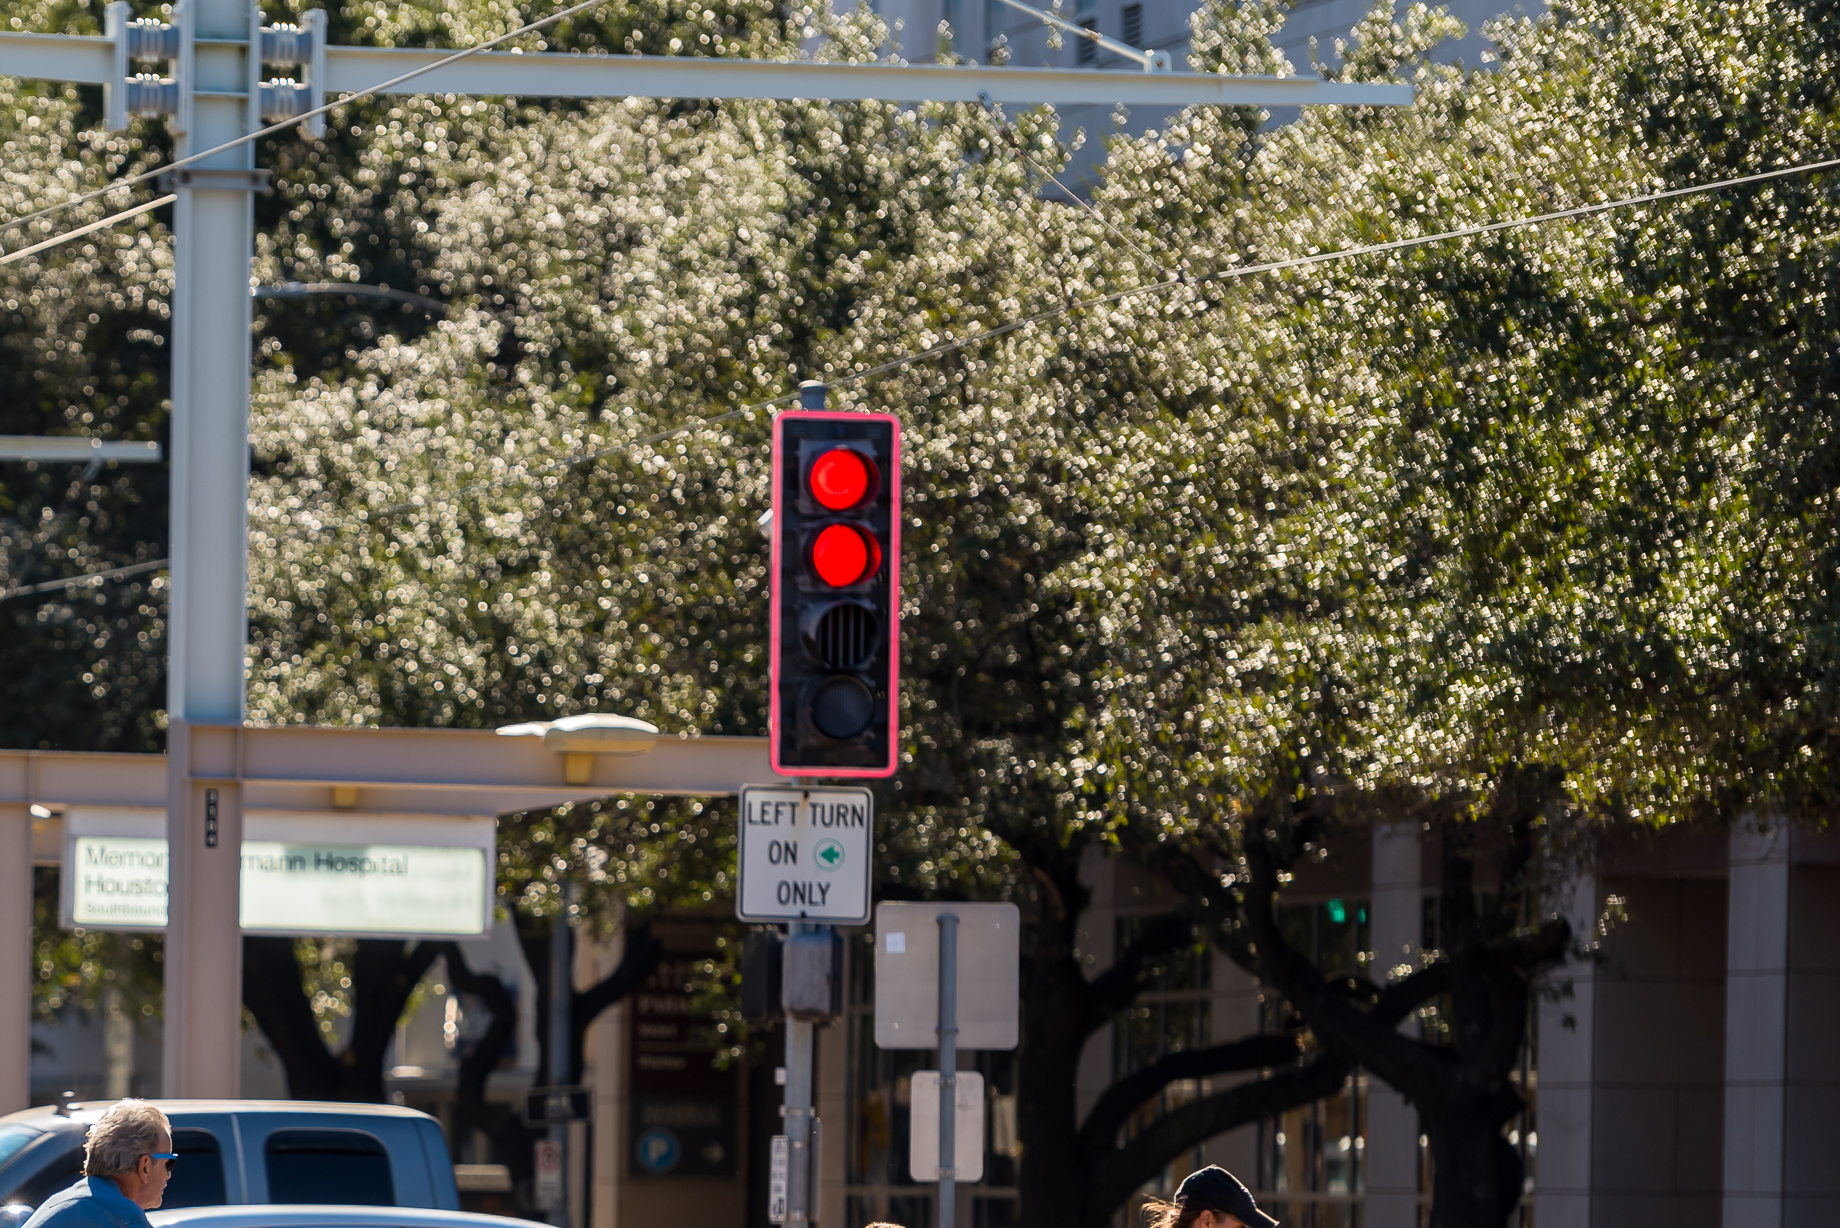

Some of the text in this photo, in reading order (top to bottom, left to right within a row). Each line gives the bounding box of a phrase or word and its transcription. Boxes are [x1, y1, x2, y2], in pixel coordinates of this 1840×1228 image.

[748, 801, 864, 829] LEFT TURN
[85, 846, 169, 870] Memor
[241, 854, 306, 872] mann
[314, 850, 408, 879] Hospital
[768, 839, 799, 866] ON
[84, 873, 168, 897] Housto
[777, 879, 831, 907] ONLY
